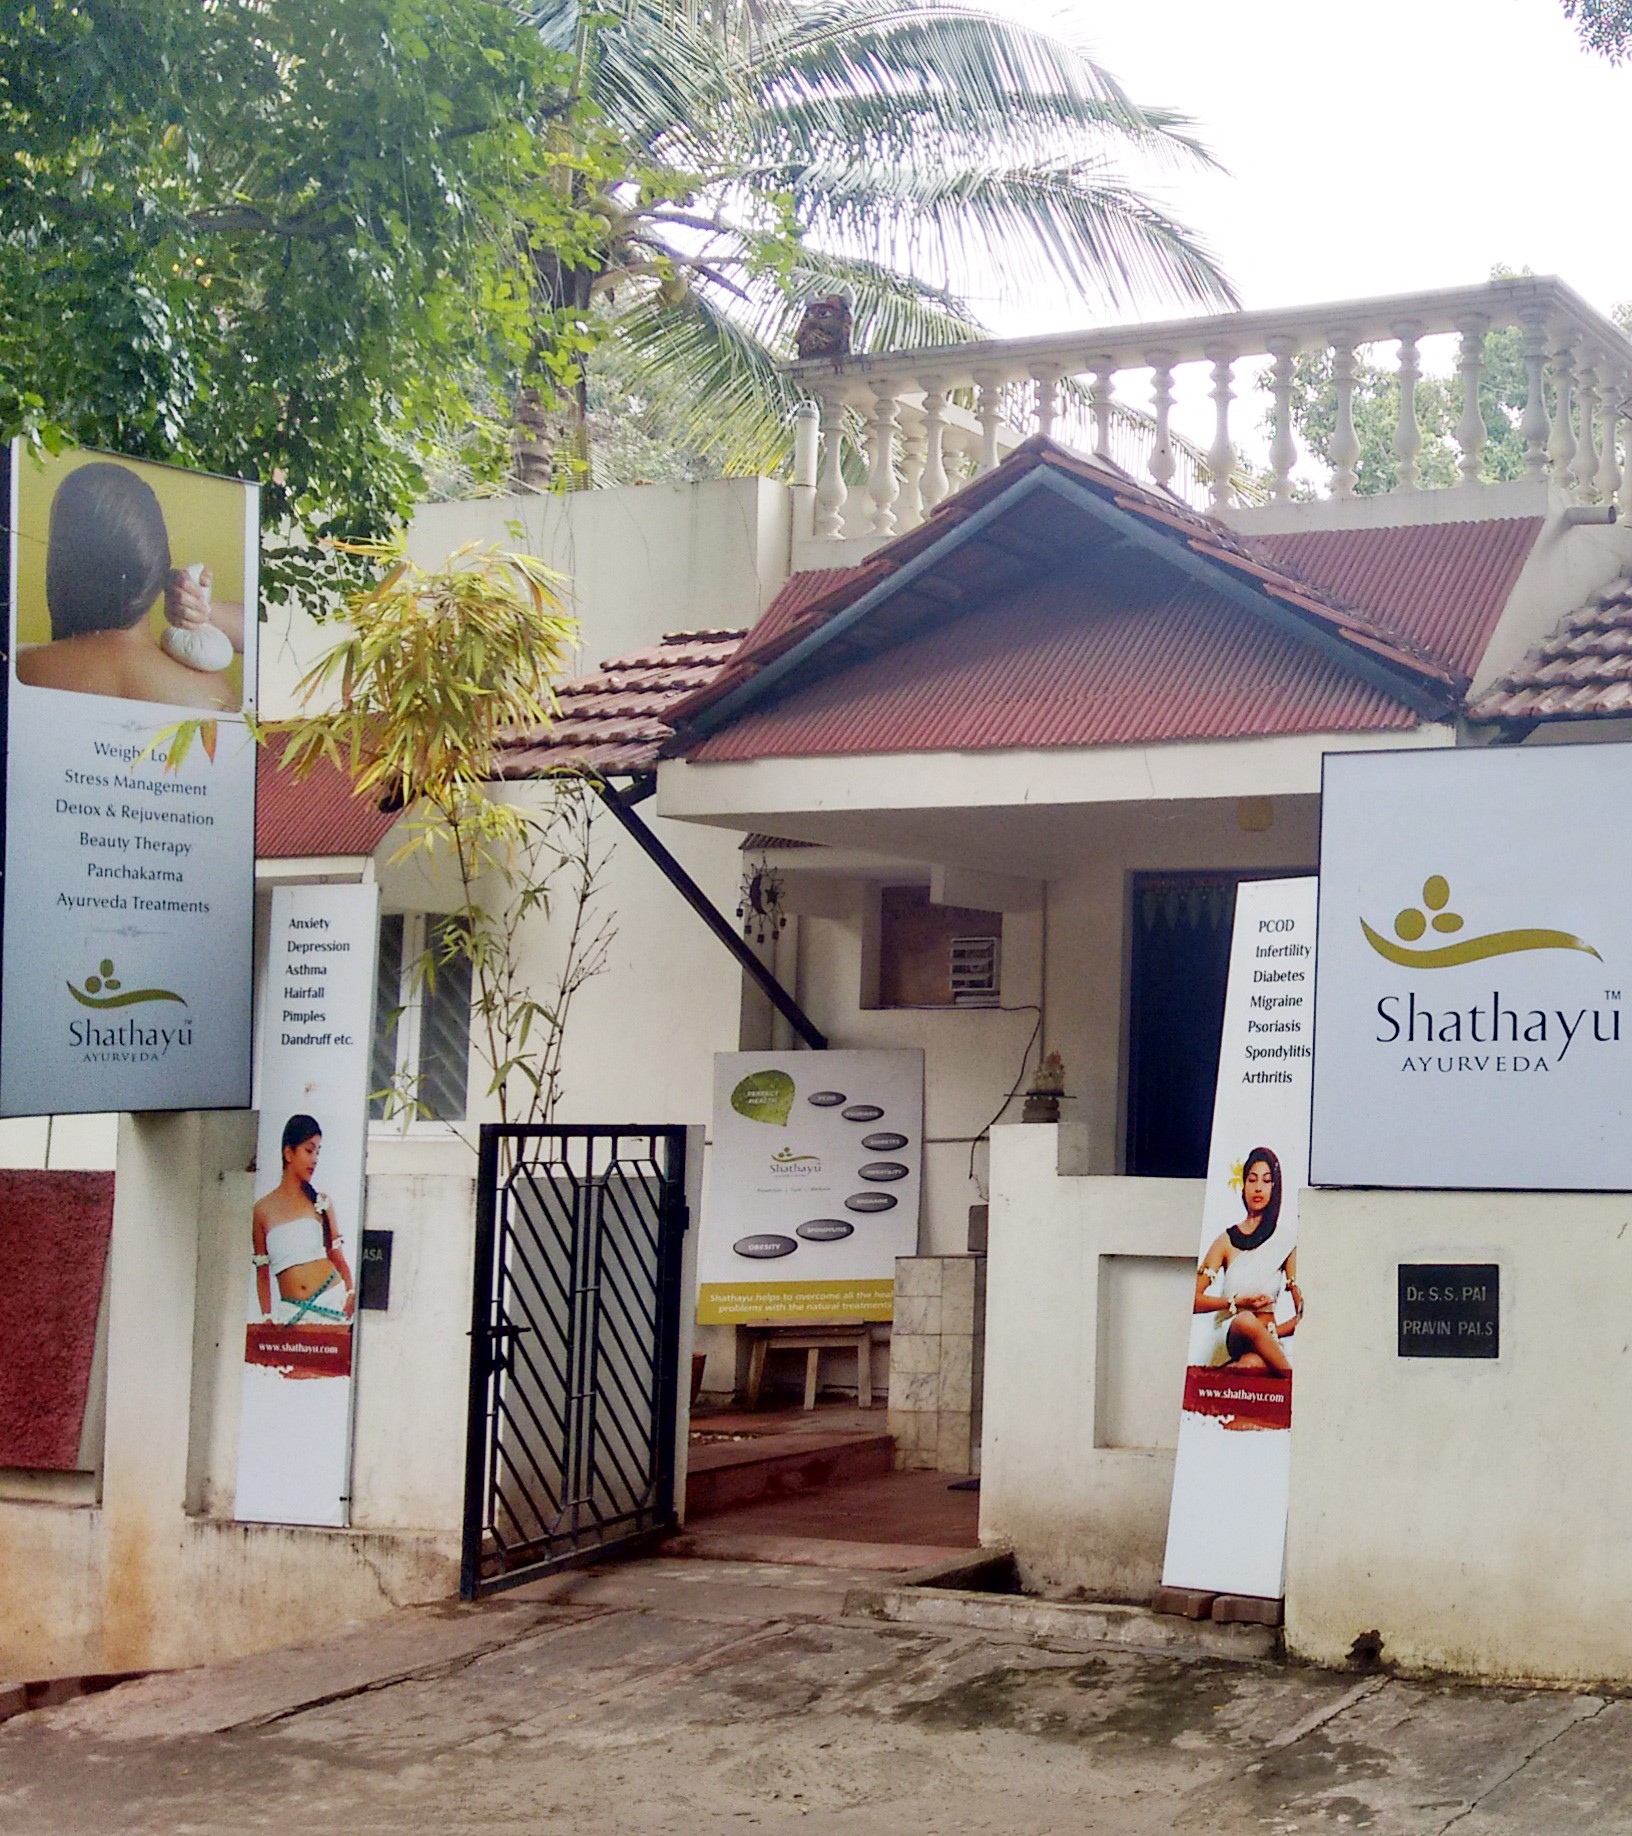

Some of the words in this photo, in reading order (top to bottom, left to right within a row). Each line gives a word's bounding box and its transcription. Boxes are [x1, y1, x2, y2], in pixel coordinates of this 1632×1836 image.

[94, 741, 148, 763] Weigh
[65, 769, 109, 787] Stress
[114, 774, 207, 796] Management
[56, 799, 101, 817] Detox
[106, 803, 117, 818] &
[121, 805, 215, 826] Rejuvenation
[80, 832, 130, 850] Beauty
[134, 836, 192, 856] Therapy
[87, 863, 184, 882] Panchakarma
[57, 892, 127, 910] Ayurveda
[132, 896, 210, 914] Treatments
[288, 917, 331, 931] Anxiety
[1258, 919, 1295, 933] PCOD
[287, 940, 350, 955] Depression
[1256, 944, 1312, 960] Infertility
[285, 964, 327, 976] Asthma
[1253, 970, 1305, 983] Diabetes
[284, 987, 325, 999] Hairfall
[1250, 995, 1303, 1011] Migraine
[282, 1010, 326, 1024] Pimples
[1248, 1020, 1301, 1033] Psoriasis
[1376, 991, 1621, 1062] Shathayu
[69, 1019, 192, 1055] Shathayu
[281, 1033, 332, 1045] Dandruff
[334, 1034, 353, 1045] etc.
[83, 1052, 159, 1063] AYURVEDA
[1245, 1044, 1311, 1061] Spondylitis
[1401, 1056, 1550, 1073] AYURVEDA
[1242, 1070, 1293, 1084] Arthritis
[769, 1163, 822, 1174] Shathayu
[748, 1243, 781, 1251] OBESITY
[710, 1294, 753, 1304] Shathayu
[756, 1292, 780, 1302] helps
[783, 1293, 793, 1301] to
[796, 1293, 840, 1301] overcome
[843, 1291, 854, 1299] all
[857, 1291, 872, 1299] the
[1406, 1286, 1425, 1301] Dr.
[718, 1304, 762, 1313] problems
[765, 1303, 785, 1311] with
[788, 1303, 804, 1311] the
[806, 1302, 840, 1311] natural
[843, 1301, 892, 1310] treatments
[1403, 1320, 1451, 1335] PRAVIN
[258, 1342, 338, 1355] www.shathayu.com
[1198, 1387, 1284, 1403] www.shathayu.com
